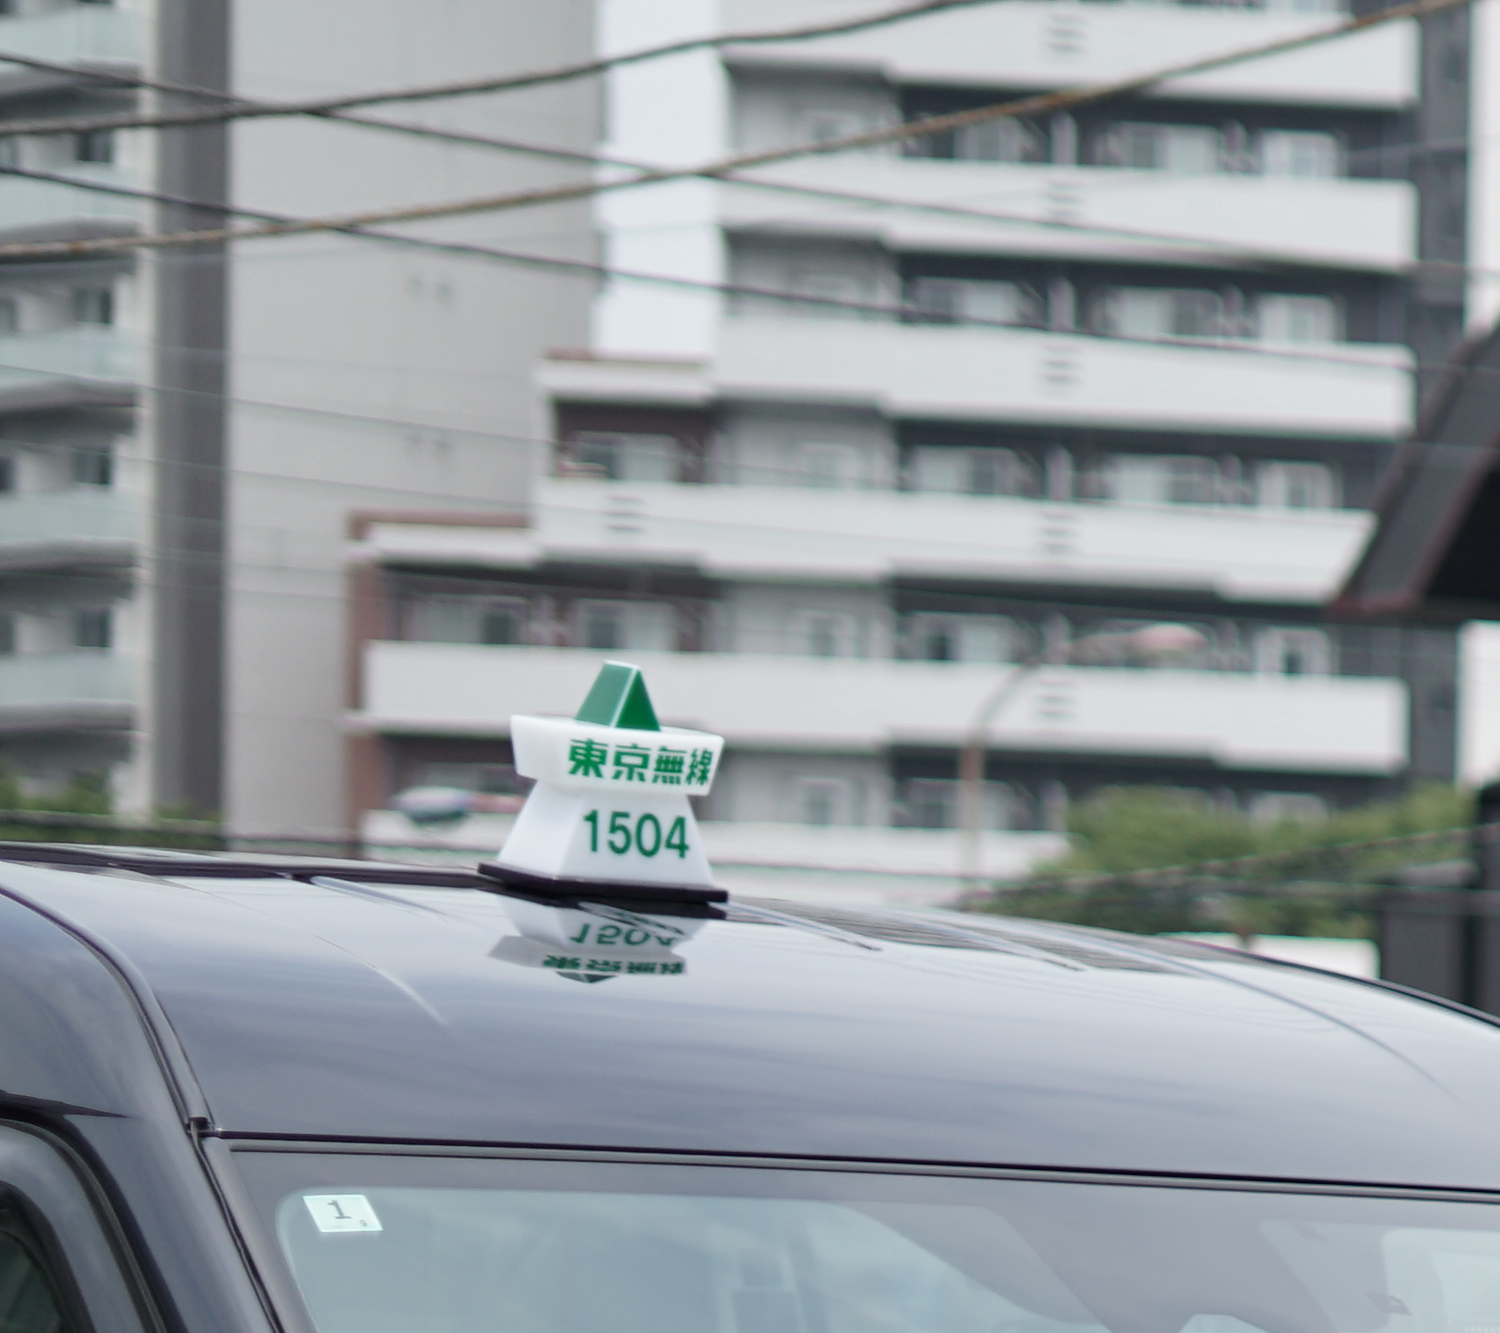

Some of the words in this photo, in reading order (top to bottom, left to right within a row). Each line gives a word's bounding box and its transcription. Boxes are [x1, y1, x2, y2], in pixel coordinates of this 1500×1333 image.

[568, 738, 714, 786] 東京無線
[583, 810, 690, 859] 1504
[327, 1200, 352, 1219] 1
